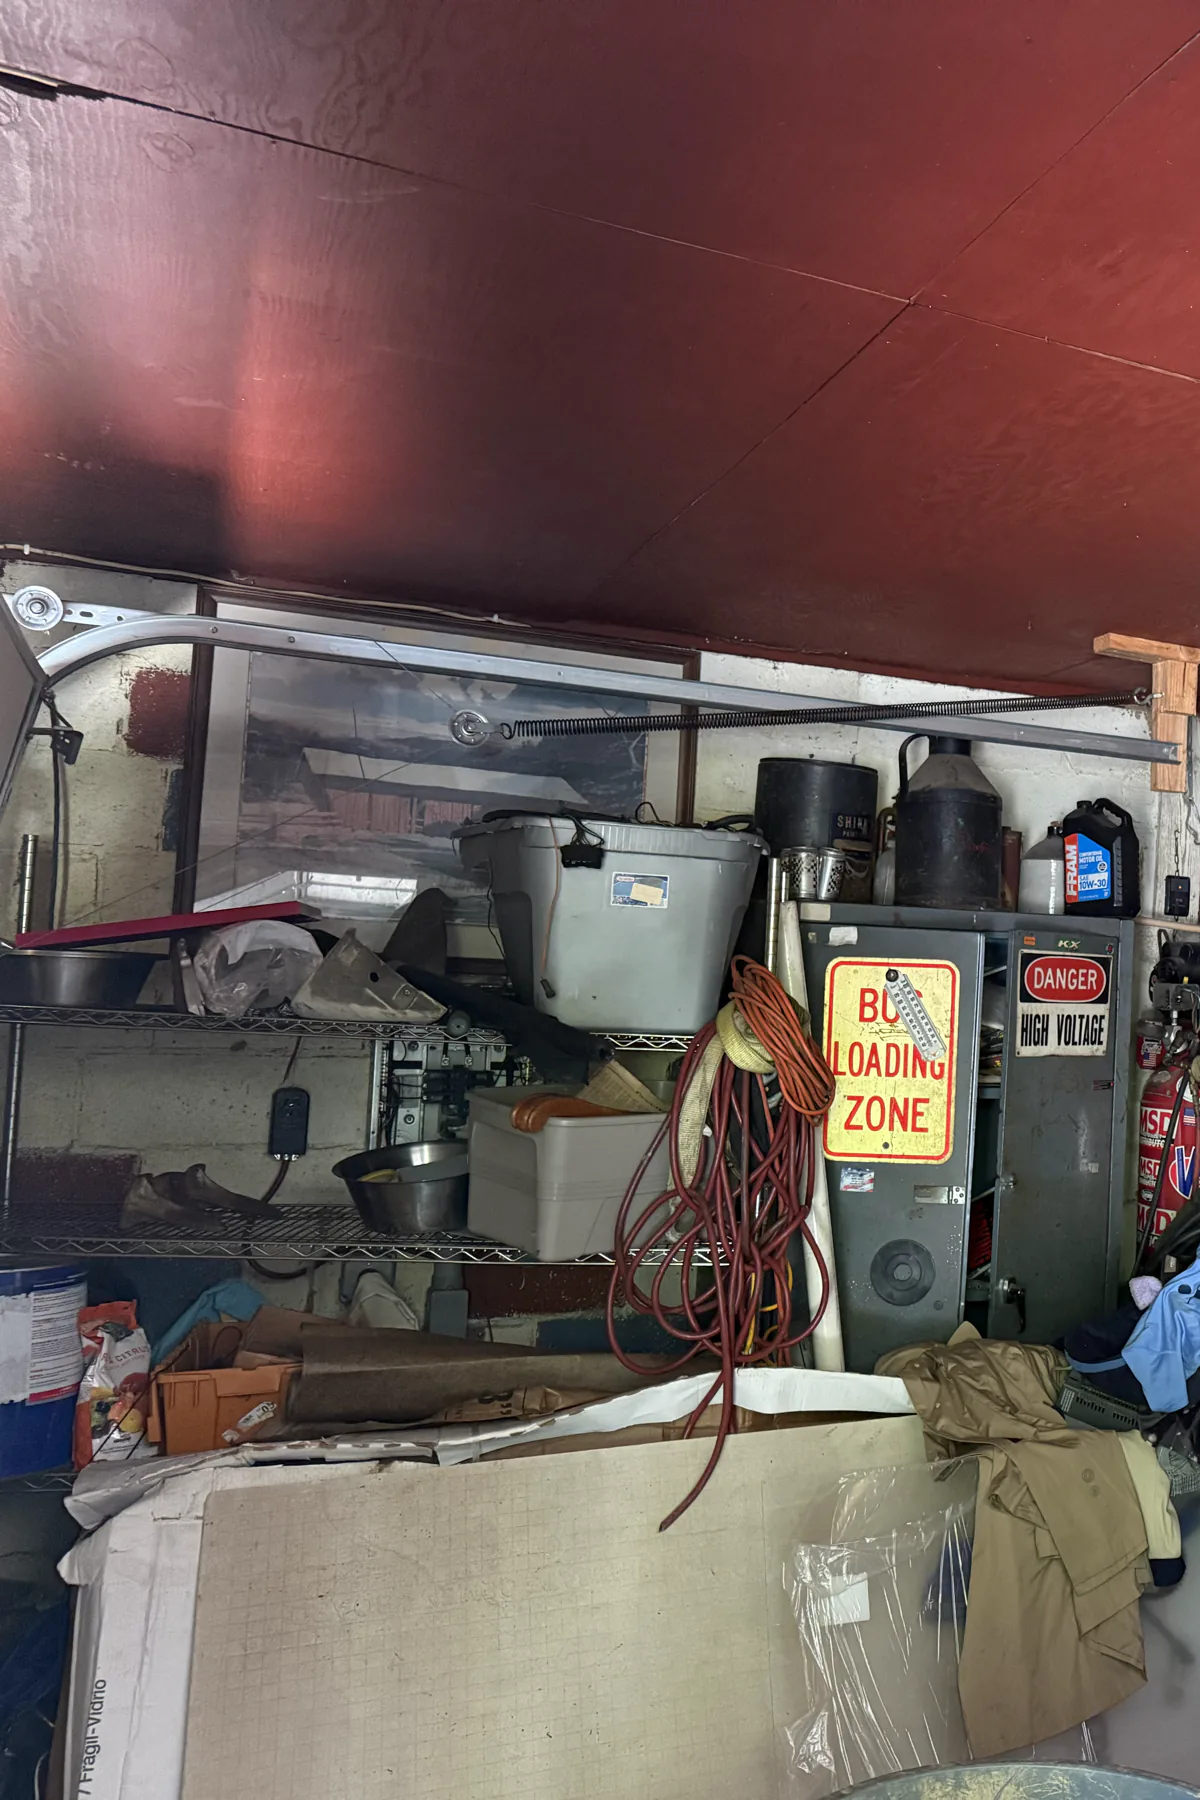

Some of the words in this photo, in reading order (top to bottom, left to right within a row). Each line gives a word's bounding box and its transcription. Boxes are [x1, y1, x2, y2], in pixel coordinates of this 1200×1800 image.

[1065, 845, 1077, 896] FRAM
[1079, 856, 1095, 864] MOTOR
[1079, 879, 1107, 890] 10W-30
[1034, 967, 1097, 990] DANGER
[859, 987, 923, 1024] BU
[1021, 1014, 1049, 1047] HIGH
[1057, 1014, 1105, 1047] VOLTAGE
[833, 1041, 946, 1080] LOADING
[844, 1095, 930, 1133] ZONE
[1140, 1109, 1174, 1138] MSD
[79, 1679, 107, 1784] Fragil-Vidrio
